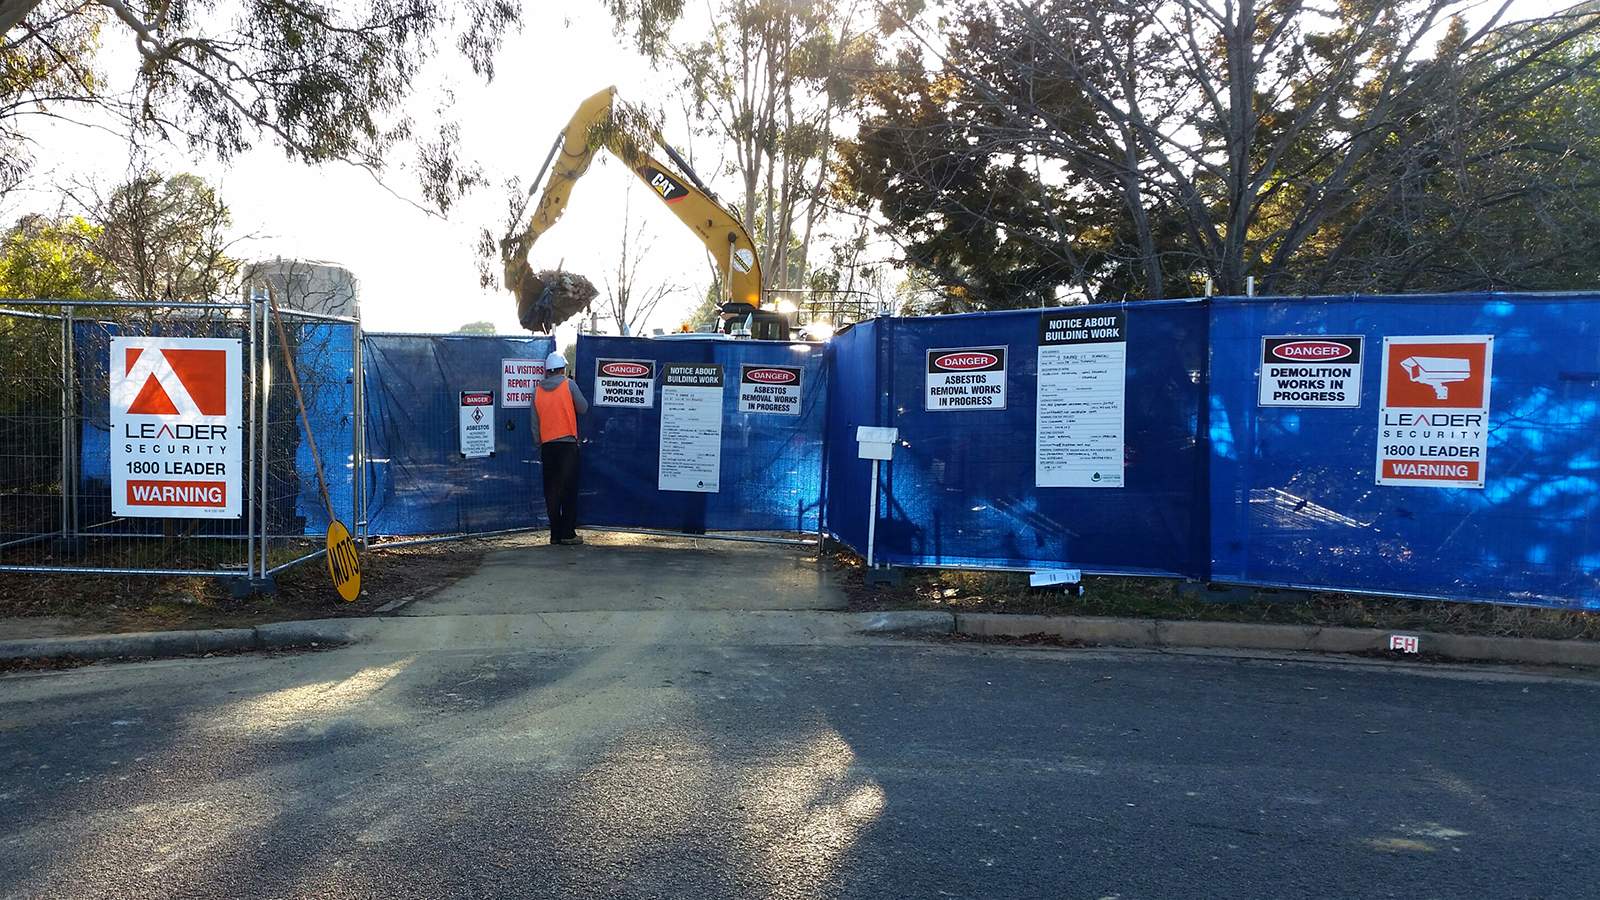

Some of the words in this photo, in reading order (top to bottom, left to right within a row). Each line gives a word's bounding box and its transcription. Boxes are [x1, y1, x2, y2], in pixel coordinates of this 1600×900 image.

[651, 173, 675, 197] CAT
[1049, 318, 1082, 330] NOTICE
[1084, 316, 1117, 328] ABOUT
[1045, 330, 1089, 341] BUILDING
[1090, 328, 1120, 339] WORK
[1284, 347, 1340, 356] DANGER
[944, 356, 988, 366] DANGER
[504, 365, 515, 374] ALL
[517, 366, 544, 375] VISITORS
[609, 366, 642, 374] DANGER
[670, 367, 694, 375] NOTICE
[694, 368, 717, 376] ABOUT
[1270, 368, 1352, 378] DEMOLITION
[667, 375, 698, 384] BUILDING
[699, 376, 719, 384] WORK
[754, 372, 789, 380] DANGER
[944, 375, 987, 385] ASBESTOS
[507, 379, 530, 388] REPORT
[601, 380, 649, 389] DEMOLITION
[1277, 380, 1326, 390] WORKS
[1330, 380, 1344, 390] IN
[605, 388, 634, 396] WORKS
[753, 386, 787, 395] ASBESTOS
[930, 386, 968, 396] REMOVAL
[971, 385, 1001, 395] WORKS
[506, 393, 520, 402] SITE
[521, 393, 533, 402] OFF
[602, 396, 645, 404] PROGRESS
[741, 394, 772, 402] REMOVAL
[774, 396, 798, 404] WORKS
[939, 398, 947, 406] IN
[949, 396, 993, 406] PROGRESS
[1273, 391, 1346, 401] PROGRESS
[748, 402, 755, 410] IN
[756, 403, 790, 412] PROGRESS
[1385, 413, 1482, 427] LEADER
[125, 423, 227, 440] LEADER
[1383, 430, 1480, 439] SECURITY
[125, 444, 226, 454] SECURITY
[1384, 445, 1415, 456] 1800
[1419, 445, 1480, 457] LEADER
[126, 461, 160, 474] 1800
[164, 461, 226, 475] LEADER
[1392, 463, 1469, 477] WARNING
[132, 485, 222, 503] WARNING
[1393, 636, 1416, 651] FH
